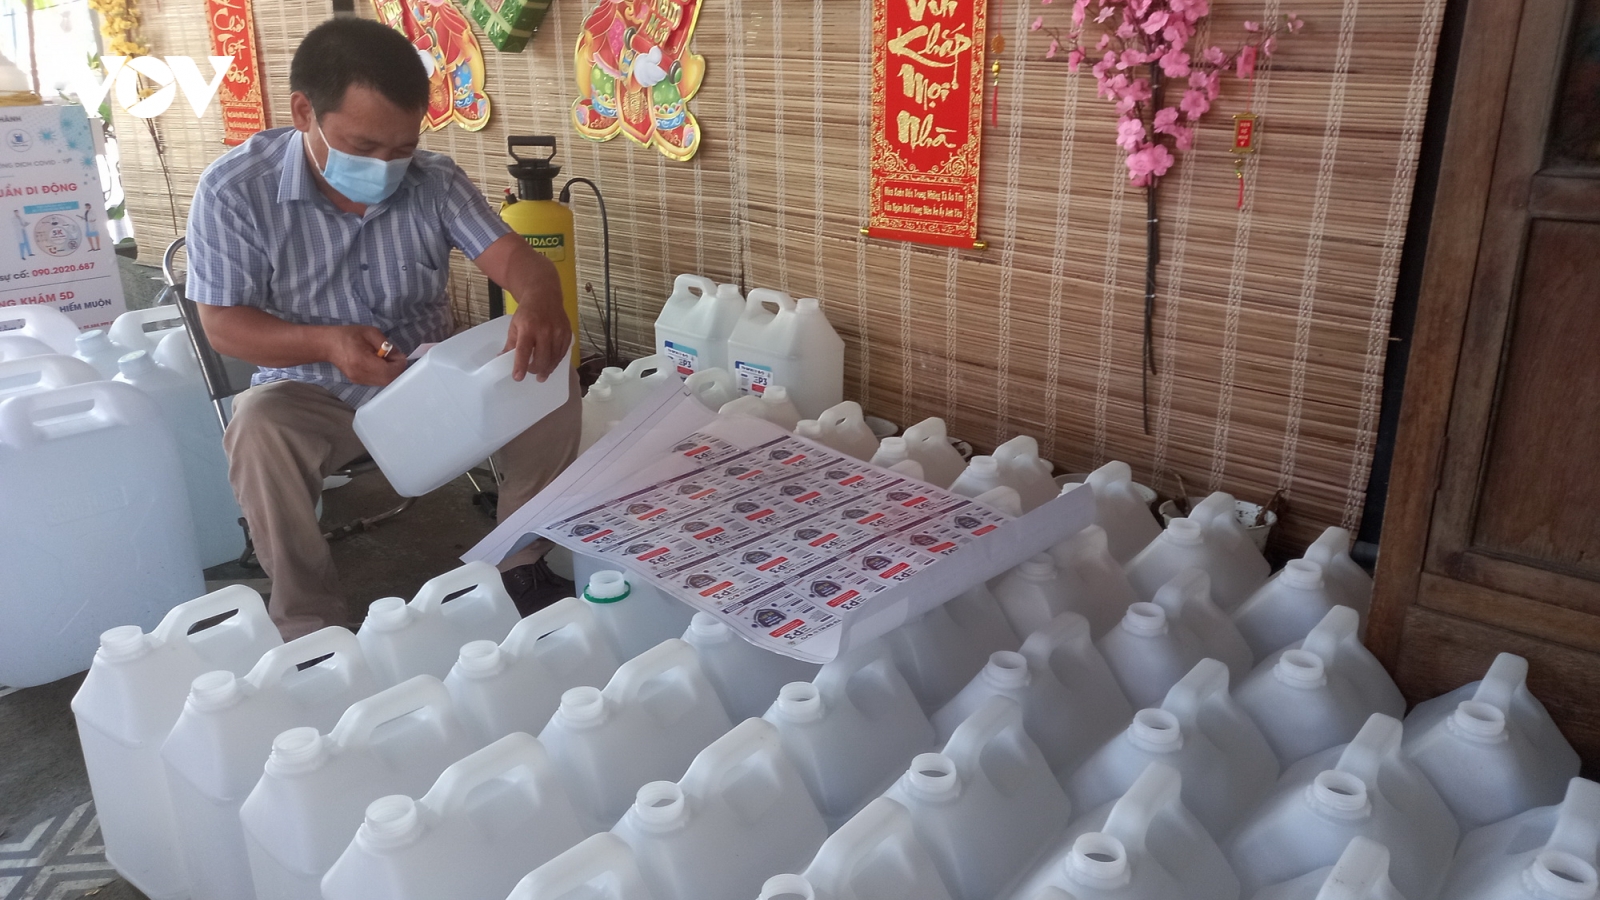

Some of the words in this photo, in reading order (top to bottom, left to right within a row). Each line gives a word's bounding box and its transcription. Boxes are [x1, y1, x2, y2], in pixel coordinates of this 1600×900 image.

[896, 63, 951, 111] Mọi
[896, 110, 957, 152] Nhà
[33, 159, 57, 167] COVID
[26, 186, 39, 195] DI
[41, 182, 78, 196] ĐỘNG
[31, 262, 95, 277] 090.2020.687
[20, 292, 57, 305] KHÁM
[59, 291, 75, 301] 5D
[59, 301, 82, 313] HIẾM
[84, 298, 113, 309] MUỘN
